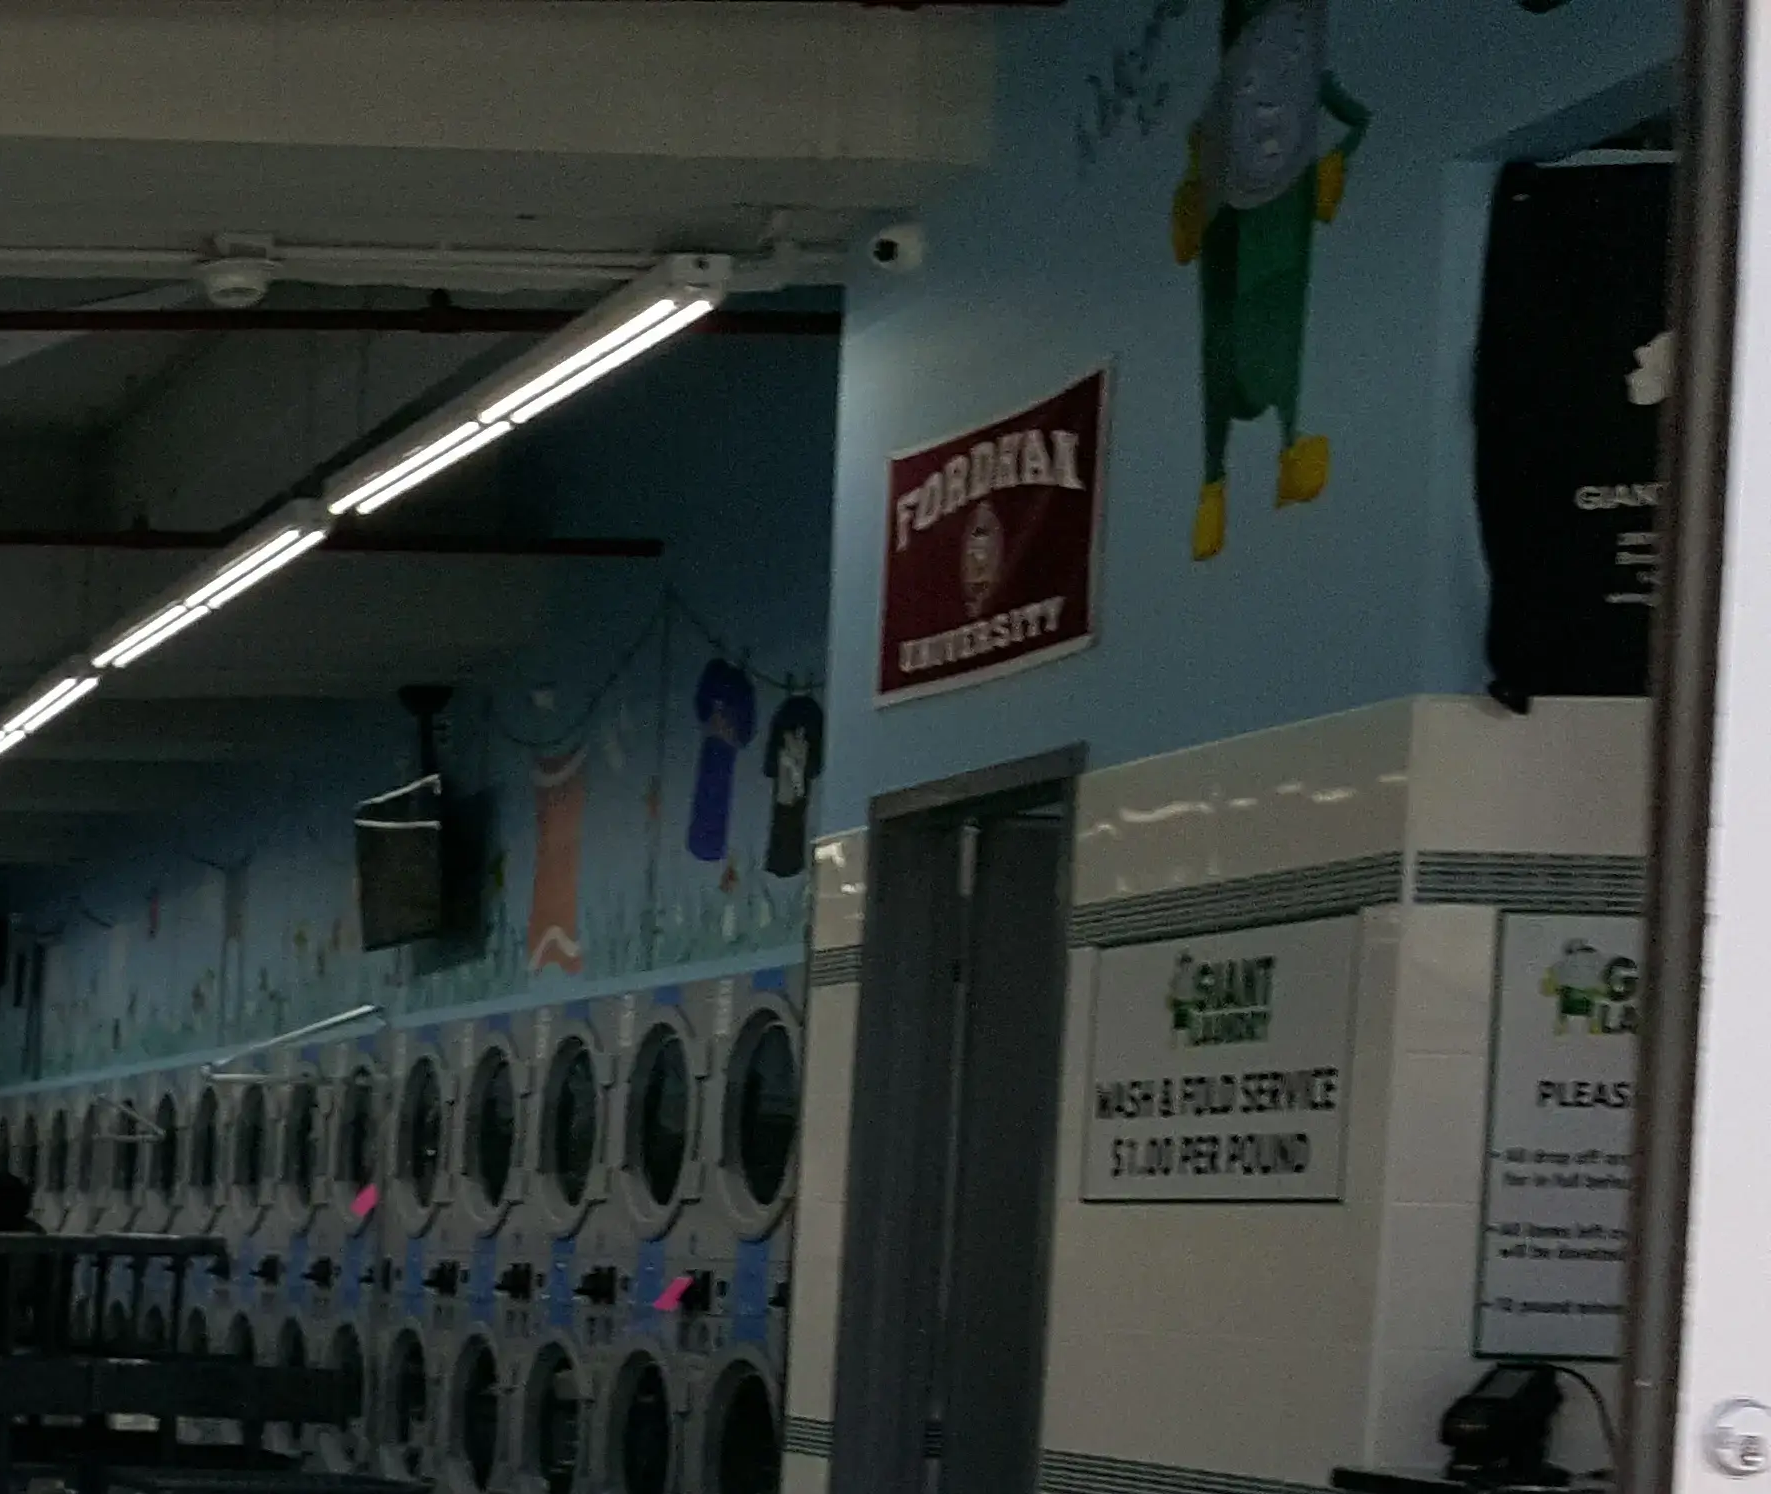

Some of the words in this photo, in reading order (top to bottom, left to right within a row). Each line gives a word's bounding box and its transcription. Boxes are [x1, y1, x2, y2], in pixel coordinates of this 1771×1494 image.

[896, 428, 1086, 552] FORDHAM
[898, 596, 1066, 673] UNIVERSITY
[1193, 956, 1276, 1009] GIANT
[1096, 1080, 1154, 1119] WASH
[1158, 1079, 1176, 1117] &
[1180, 1075, 1236, 1115] FOLD
[1239, 1068, 1338, 1114] SERVICE
[1537, 1080, 1633, 1110] PLEAS
[1111, 1138, 1174, 1177] $1.00
[1178, 1135, 1221, 1175] PER
[1225, 1133, 1310, 1175] POUND
